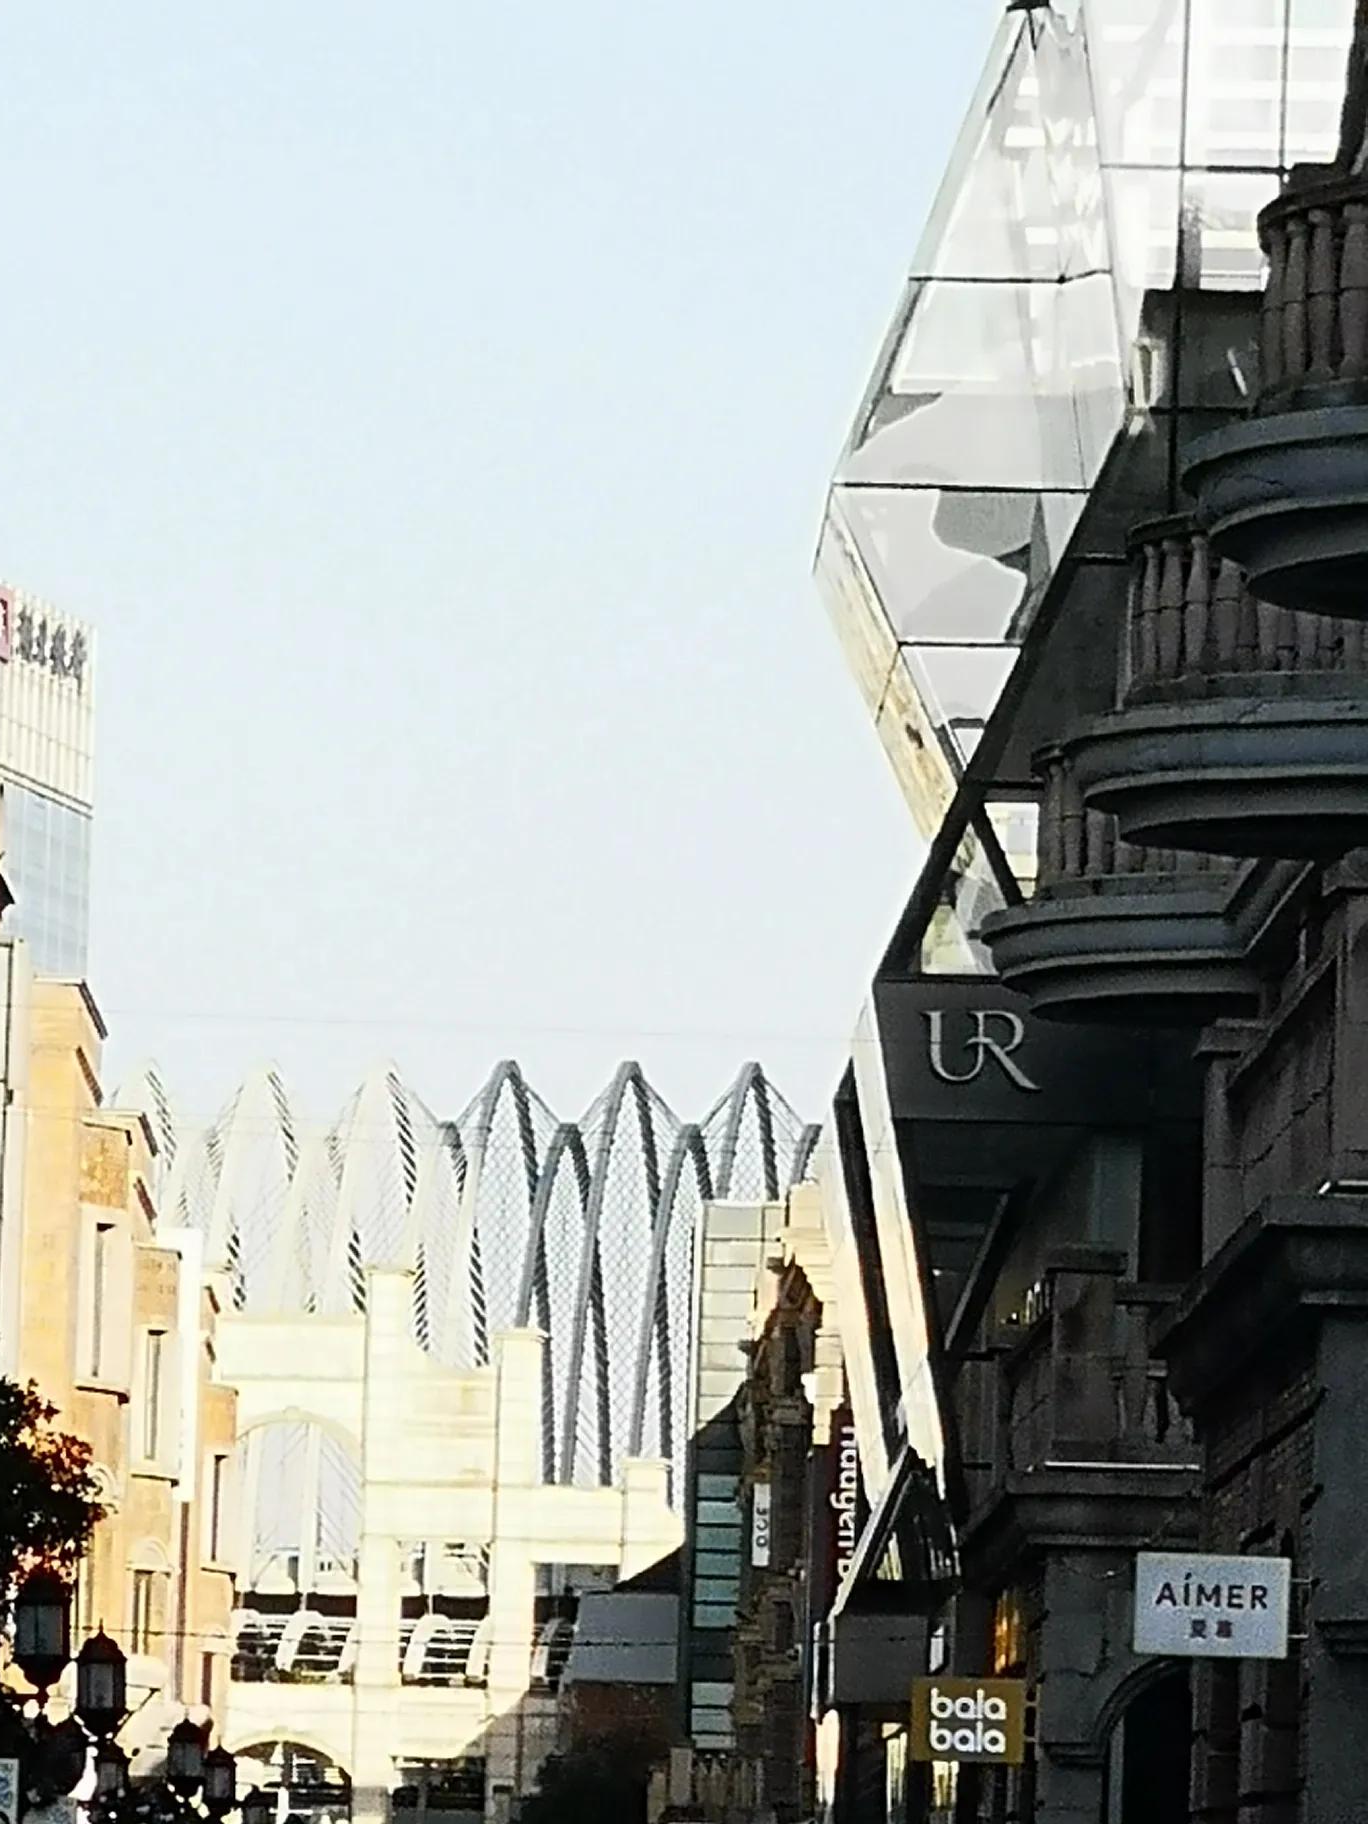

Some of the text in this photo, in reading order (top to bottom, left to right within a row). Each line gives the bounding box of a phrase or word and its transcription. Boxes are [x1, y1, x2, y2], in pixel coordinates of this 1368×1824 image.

[922, 1010, 1041, 1090] UR
[930, 1687, 1008, 1720] bala
[929, 1720, 1007, 1754] bala
